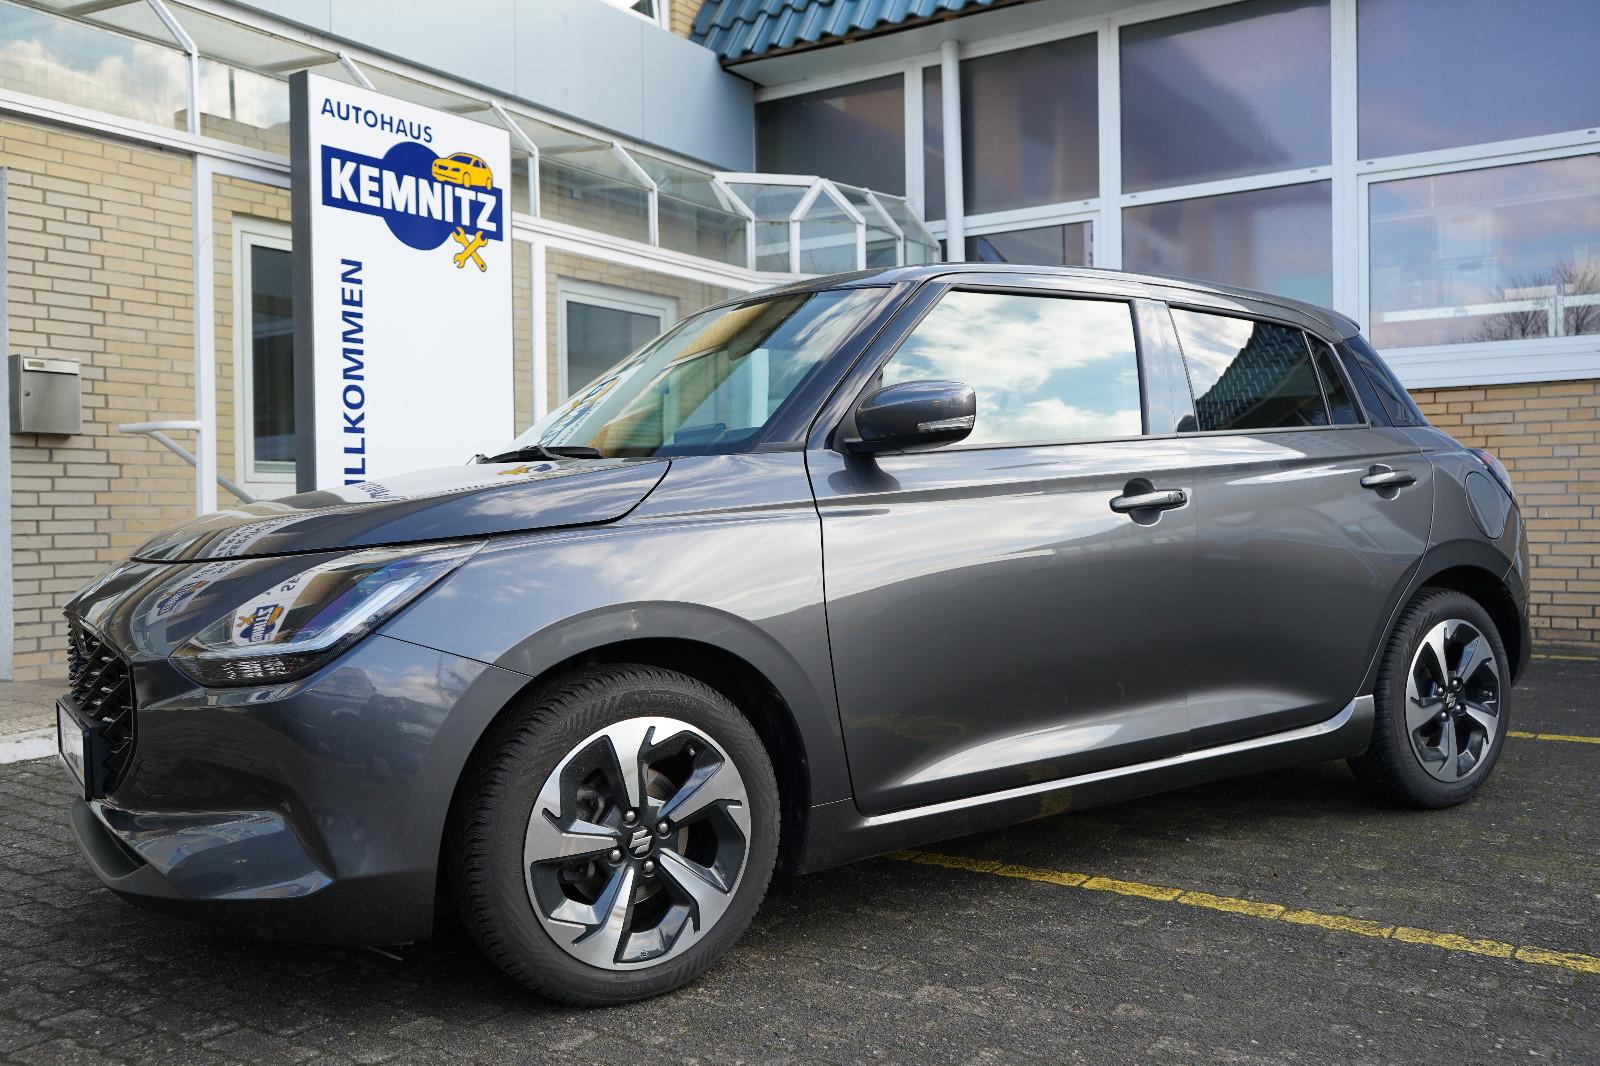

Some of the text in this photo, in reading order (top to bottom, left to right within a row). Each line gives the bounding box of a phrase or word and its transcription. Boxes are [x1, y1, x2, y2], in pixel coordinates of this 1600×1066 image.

[321, 98, 433, 143] AUTOHAUS
[330, 157, 497, 232] KEMNITZ
[341, 258, 366, 486] ILLKOMMEN
